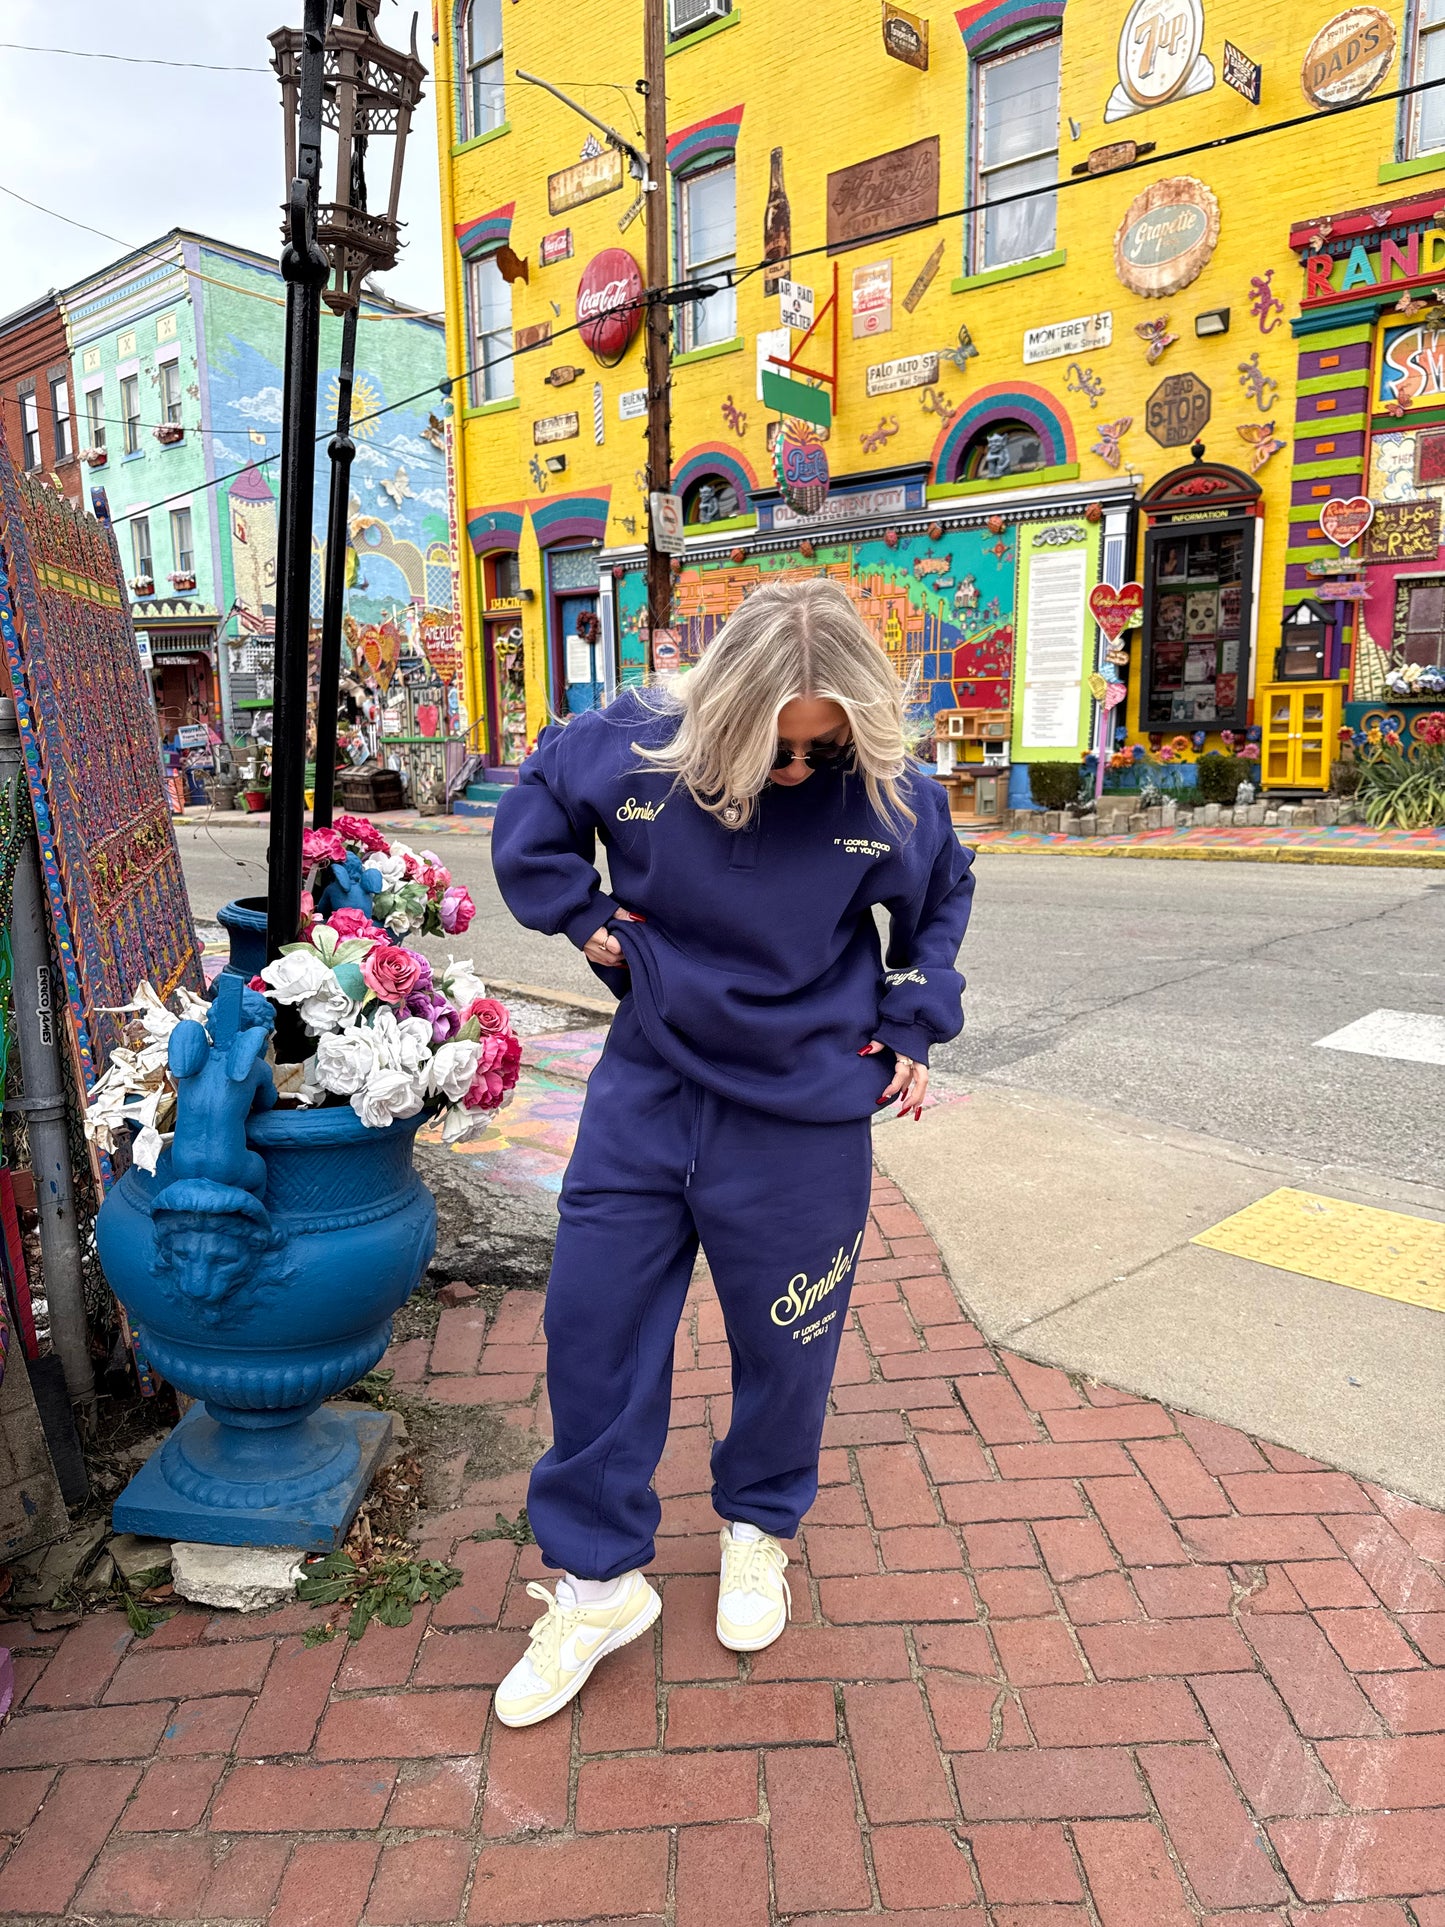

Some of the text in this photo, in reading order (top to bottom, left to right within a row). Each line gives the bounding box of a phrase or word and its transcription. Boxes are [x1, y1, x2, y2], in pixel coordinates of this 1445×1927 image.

[797, 286, 813, 304] RAID
[782, 309, 812, 330] SHELTER
[870, 363, 893, 380] PALO
[897, 360, 919, 374] ALTO
[1150, 394, 1206, 428] STOP
[1166, 426, 1188, 441] END
[775, 507, 797, 521] OLD
[872, 489, 904, 506] CITY
[1171, 509, 1229, 522] INFORMATION
[452, 570, 464, 642] WELCOME
[491, 597, 523, 610] IMAGIN
[425, 625, 455, 640] AMERIC
[456, 650, 464, 701] HOUSE
[616, 797, 666, 822] Smile!
[843, 839, 868, 847] LOOKS
[871, 841, 891, 852] GOOD
[885, 969, 928, 985] mayfair
[39, 967, 49, 1008] ENRICO
[770, 1231, 862, 1326] Smile!
[792, 1310, 837, 1340] IT LOOKS GOOD
[802, 1335, 812, 1345] ON
